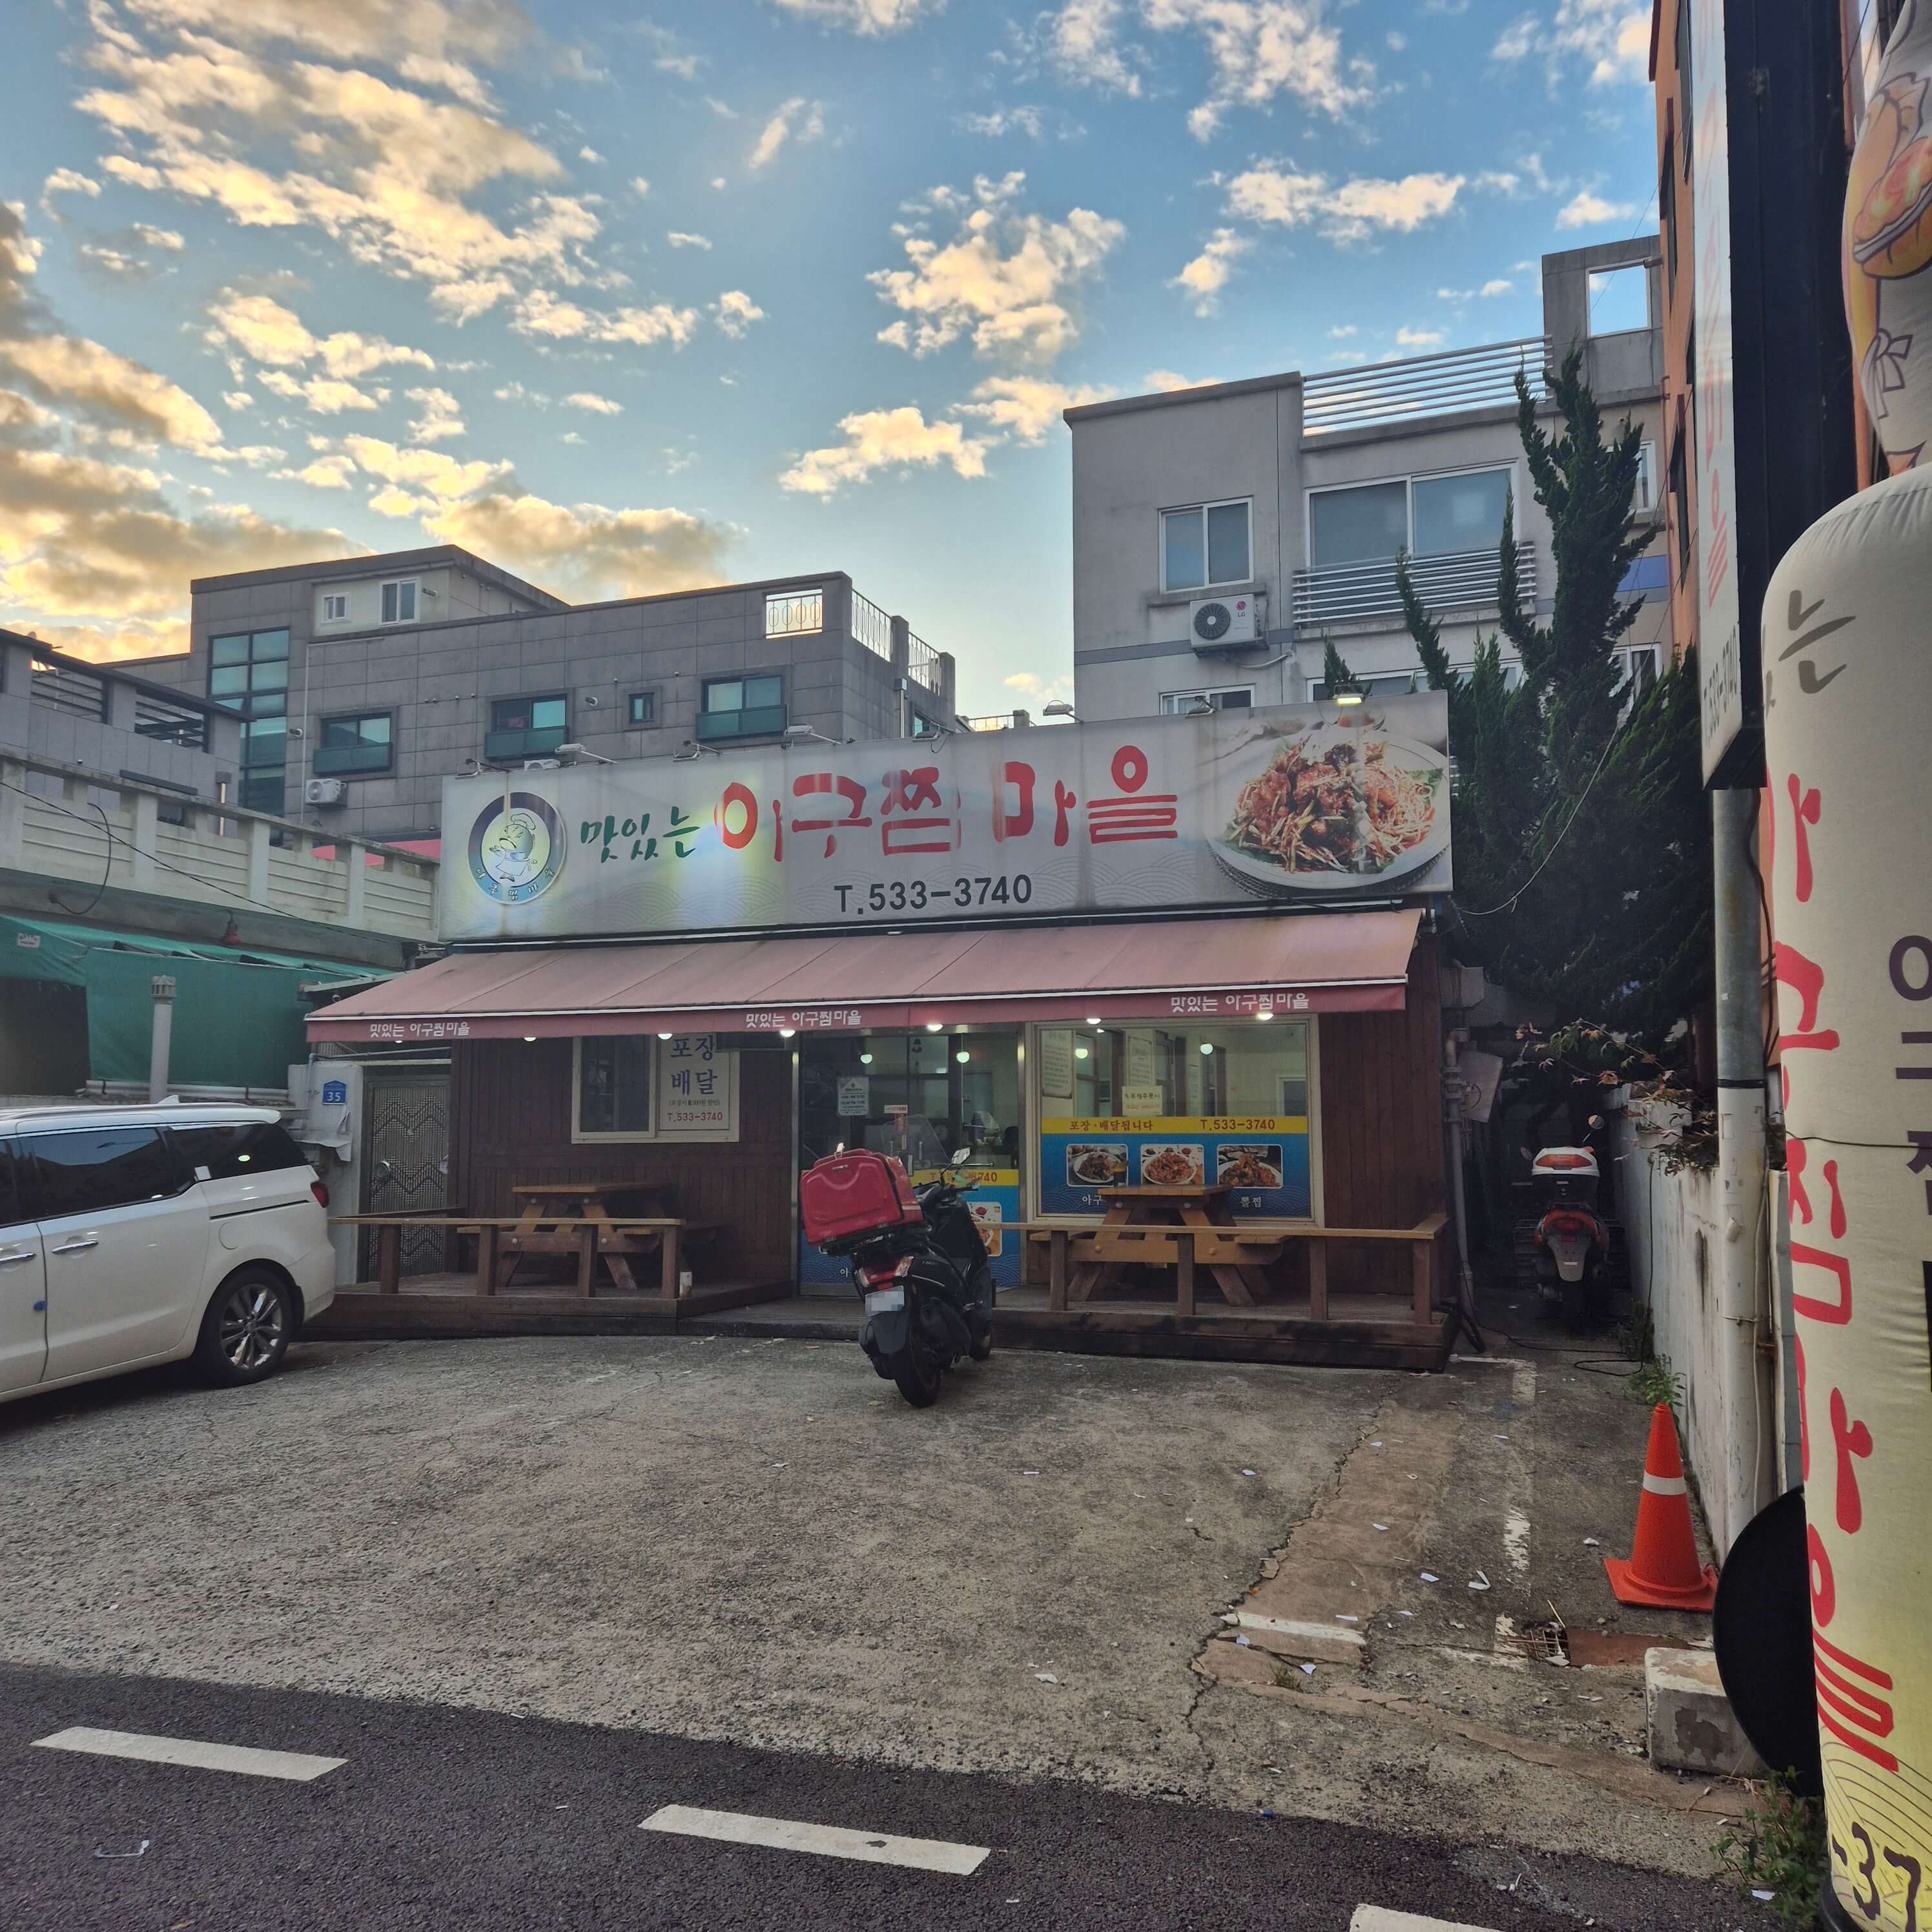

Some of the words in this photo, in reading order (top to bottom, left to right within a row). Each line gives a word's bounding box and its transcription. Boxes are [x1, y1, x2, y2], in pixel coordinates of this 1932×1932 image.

[581, 805, 701, 864] 맛있는
[834, 873, 1032, 916] T.533-3740
[1171, 996, 1219, 1013] 맛있는
[1225, 992, 1310, 1011] 아구찜마을
[745, 1012, 786, 1029] 맛있는
[792, 1009, 862, 1027] 아구찜마을
[369, 1023, 405, 1038] 맛있는
[409, 1021, 471, 1038] 아구찜마을
[670, 1034, 715, 1061] 포장
[671, 1068, 718, 1096] 배달
[327, 1091, 342, 1102] 35
[667, 1111, 723, 1122] T.533-3740
[1200, 1118, 1276, 1132] T.533-3740
